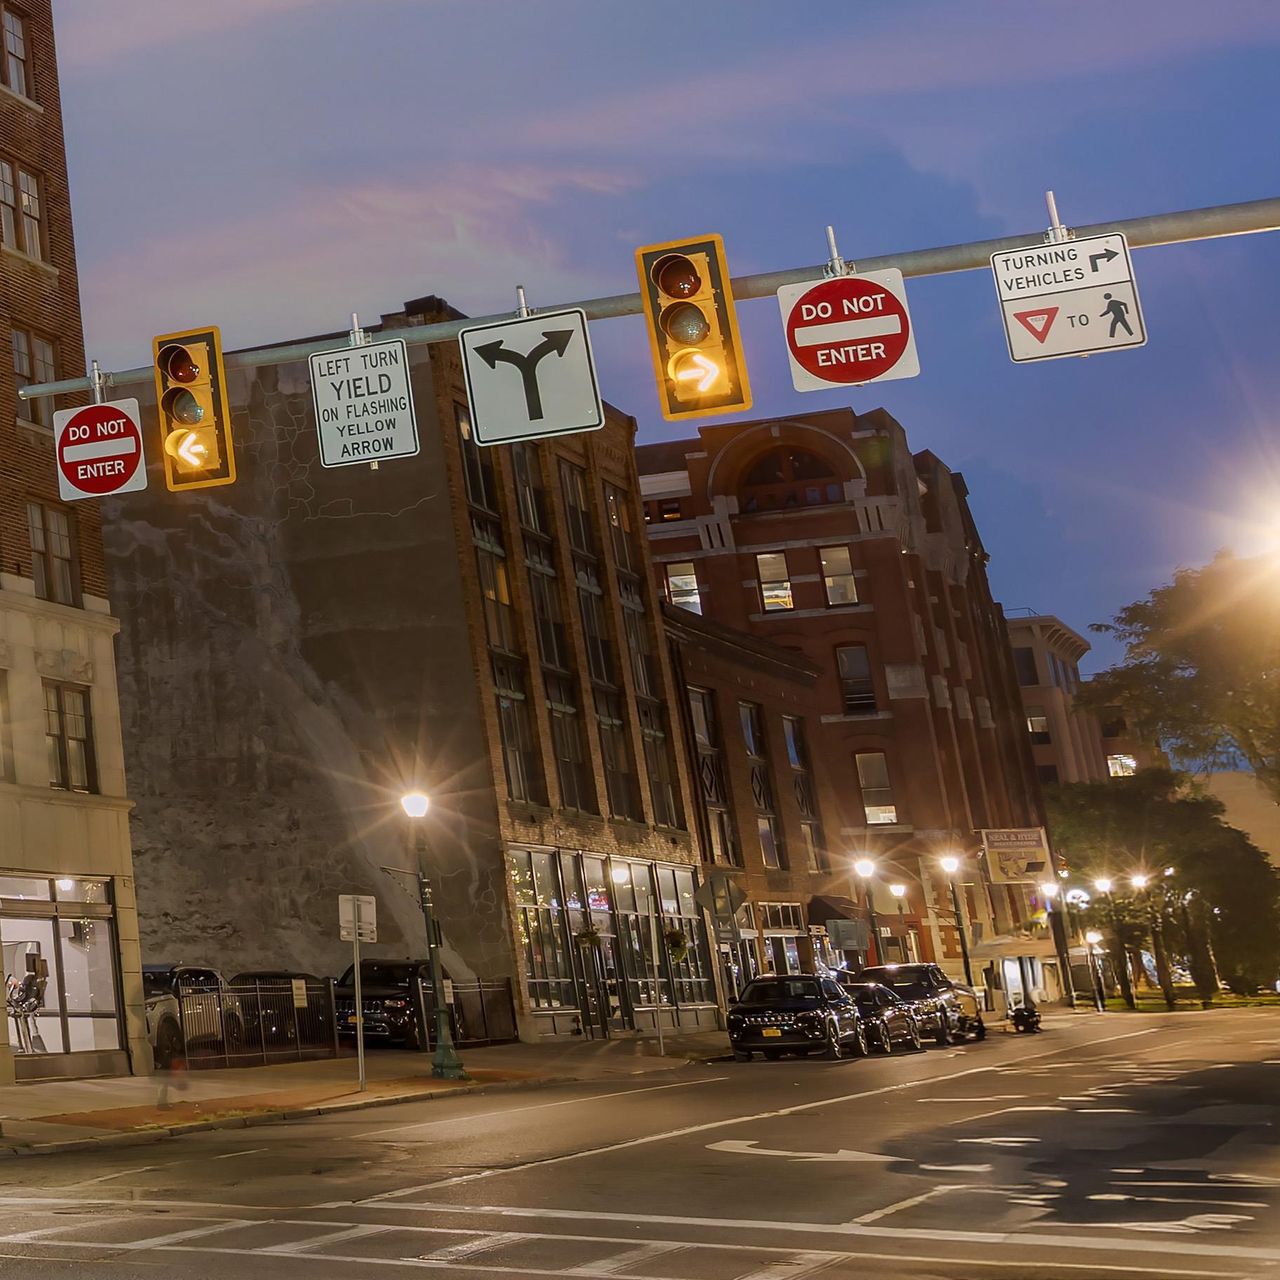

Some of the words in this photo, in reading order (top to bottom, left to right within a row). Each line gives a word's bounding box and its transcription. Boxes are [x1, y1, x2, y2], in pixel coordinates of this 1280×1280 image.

[1002, 248, 1078, 271] TURNING
[1004, 268, 1085, 291] VEHICLES
[801, 302, 832, 320] DO
[842, 293, 886, 315] NOT
[1067, 314, 1090, 328] TO
[318, 357, 351, 377] LEFT
[360, 349, 399, 370] TURN
[816, 342, 887, 367] ENTER
[330, 373, 392, 401] YIELD
[322, 407, 339, 422] ON
[346, 396, 407, 419] FLASHING
[68, 425, 90, 441] DO
[96, 419, 127, 437] NOT
[336, 418, 397, 437] YELLOW
[340, 437, 394, 458] ARROW
[77, 460, 126, 480] ENTER
